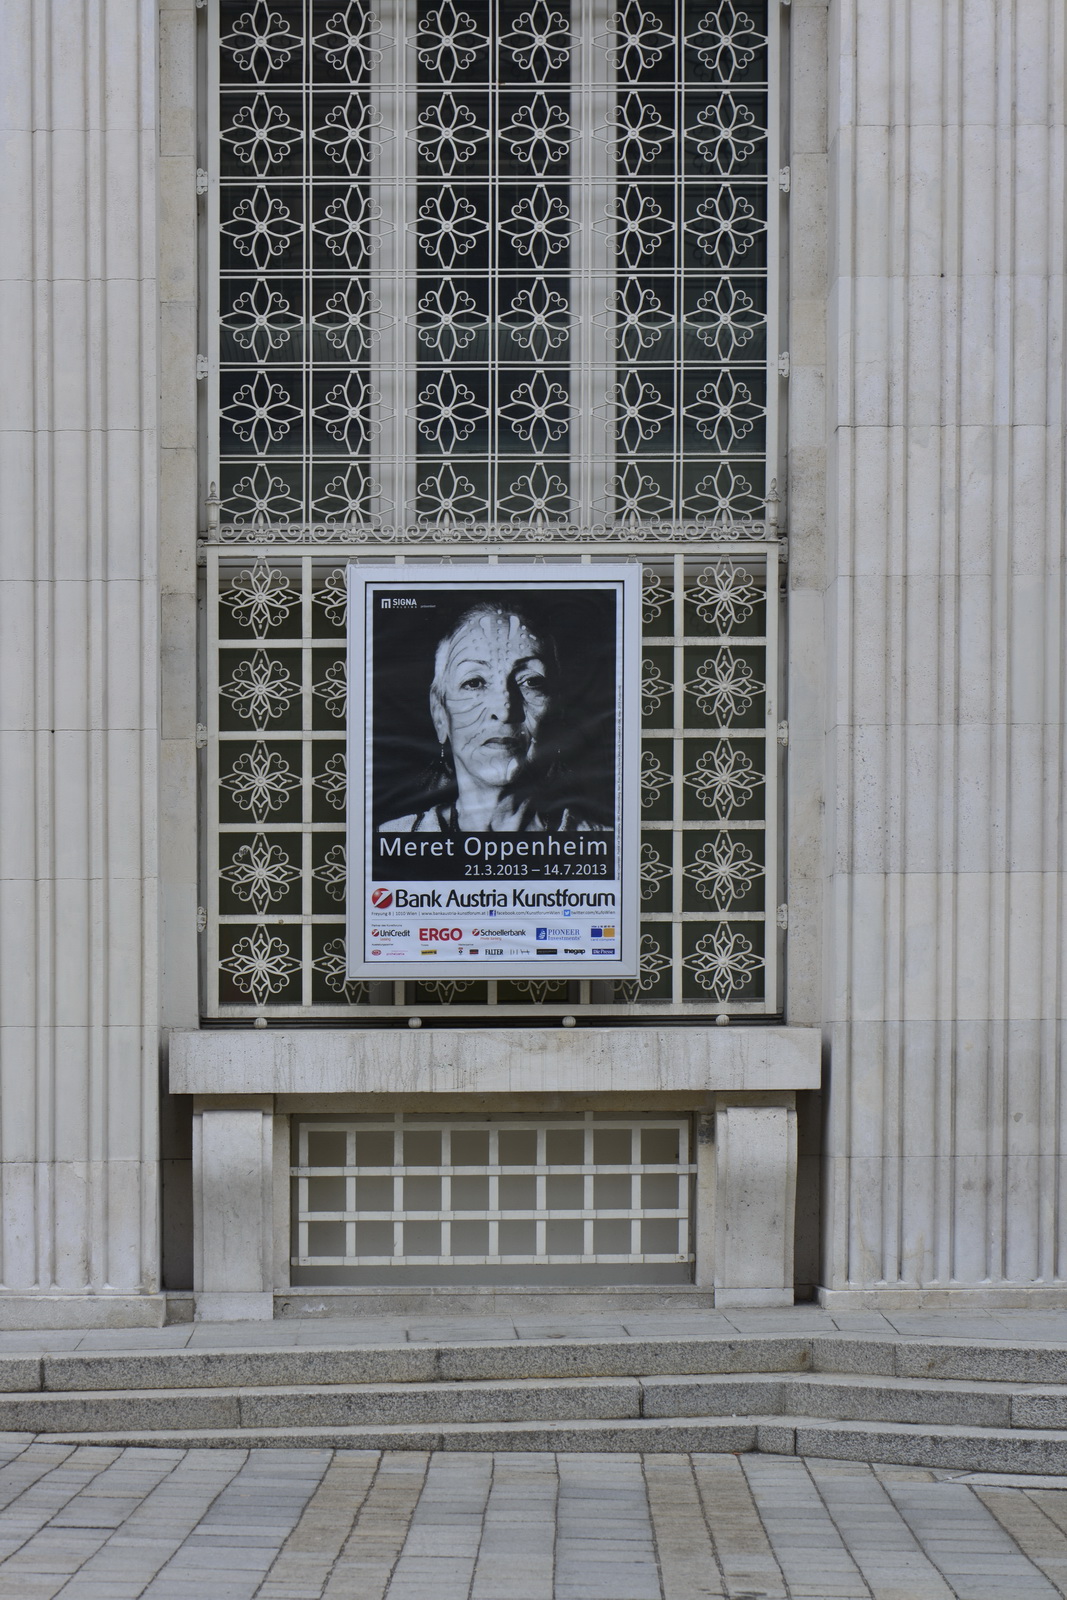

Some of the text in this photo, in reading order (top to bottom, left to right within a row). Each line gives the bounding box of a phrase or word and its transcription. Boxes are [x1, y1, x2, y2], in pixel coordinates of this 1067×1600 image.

[380, 836, 608, 861] Meret Oppenheim
[464, 864, 528, 876] 21.3.2013
[544, 864, 607, 876] 14.7.2013
[396, 888, 615, 908] Bank Austria Kunstforum
[380, 929, 410, 937] UniCredit
[419, 928, 463, 941] ERGO
